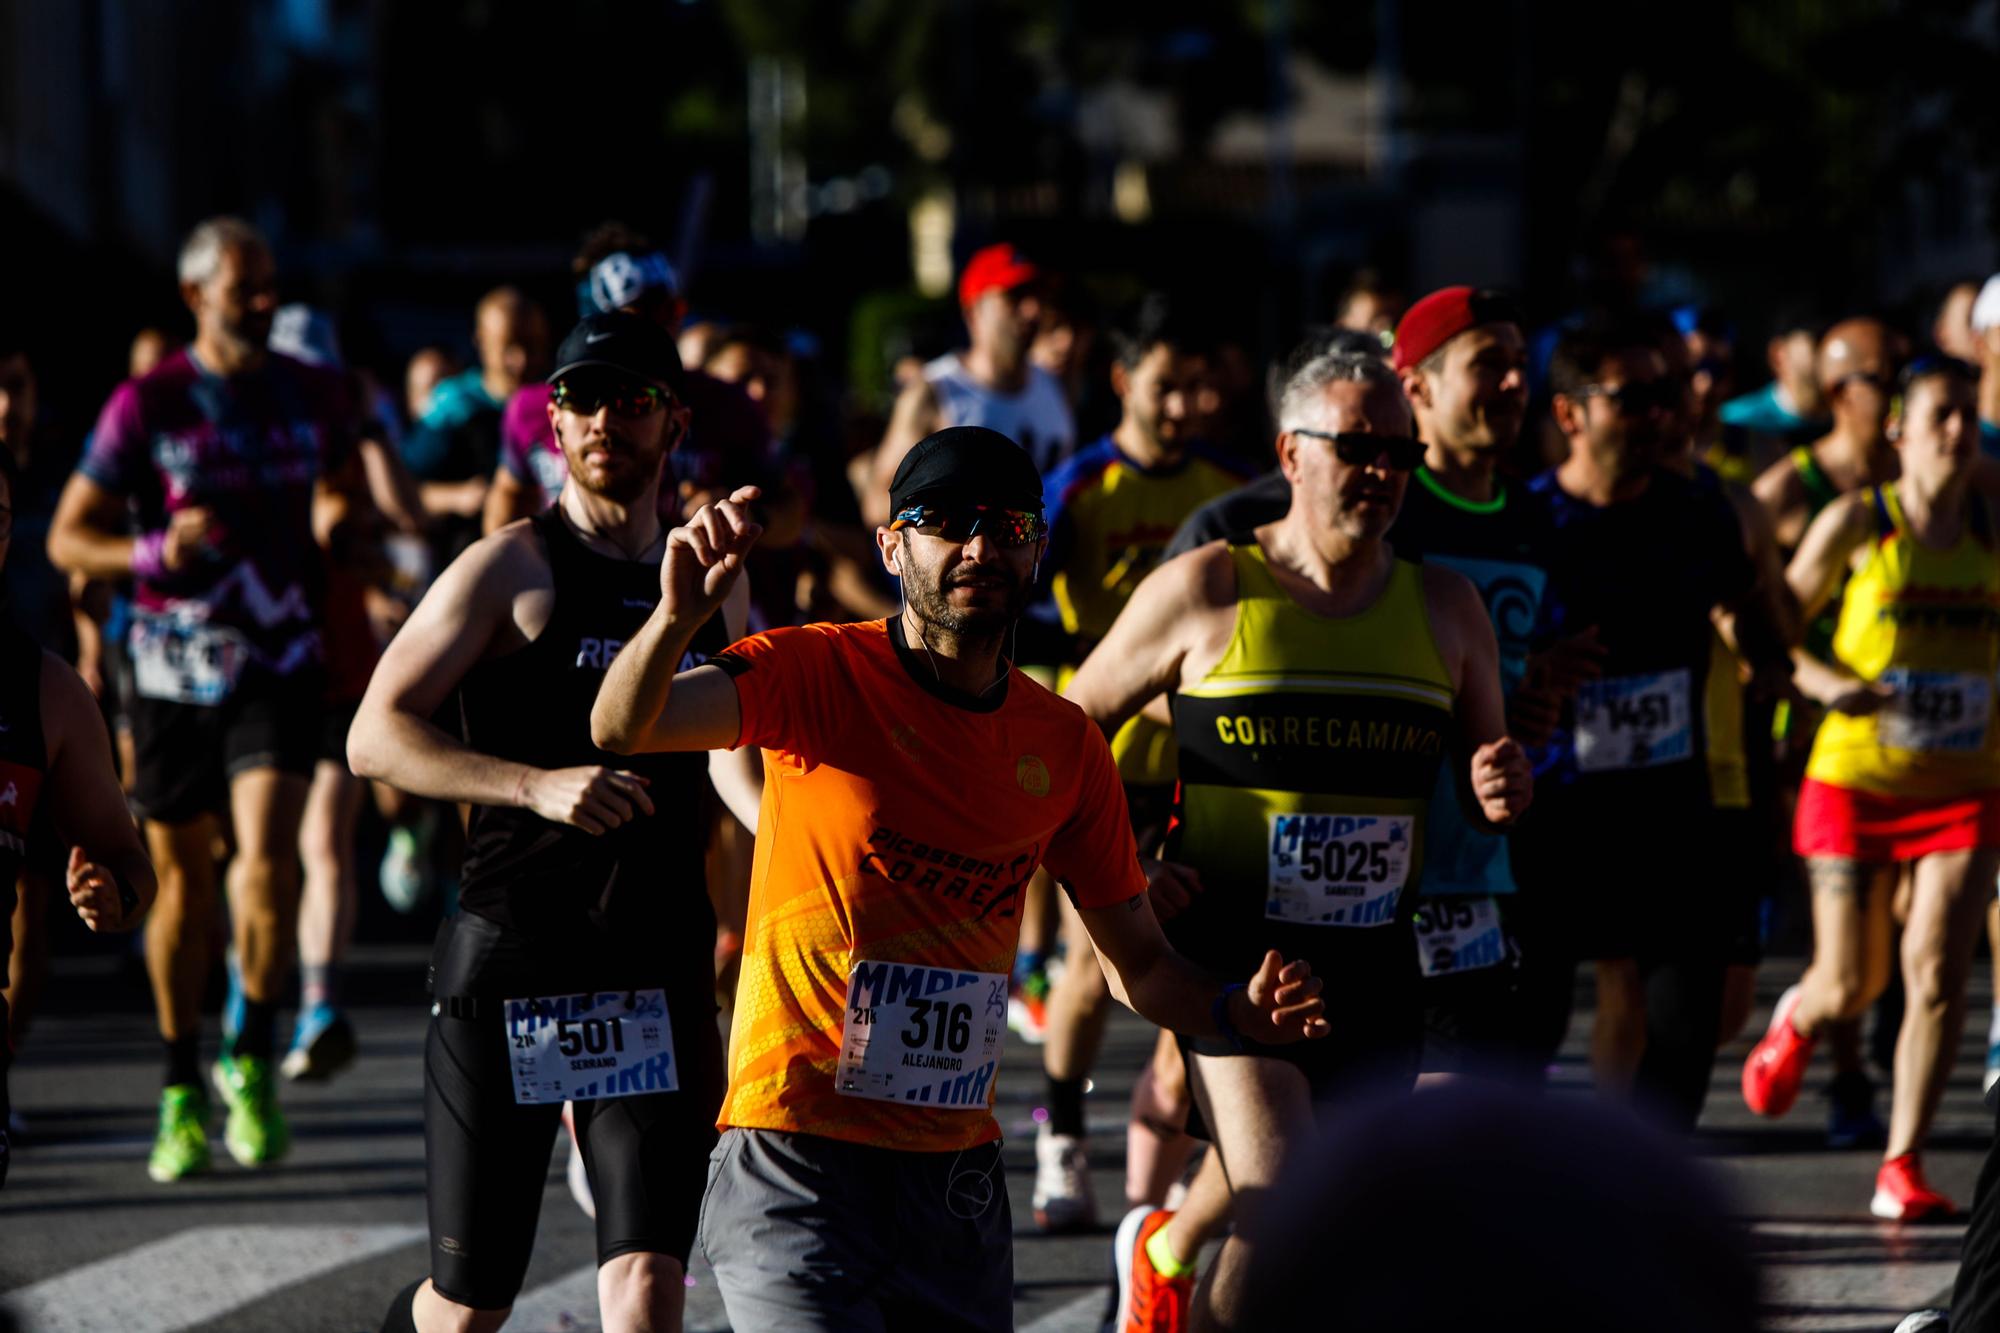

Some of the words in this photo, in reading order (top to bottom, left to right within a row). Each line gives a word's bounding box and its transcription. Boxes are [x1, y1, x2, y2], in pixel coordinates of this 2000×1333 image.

[1215, 714, 1443, 753] CORRECAMINO
[1301, 841, 1391, 882] 5025
[557, 1017, 625, 1057] 501
[901, 998, 972, 1054] 316
[569, 1056, 618, 1071] SERRANO
[902, 1052, 963, 1071] ALEJANDRO
